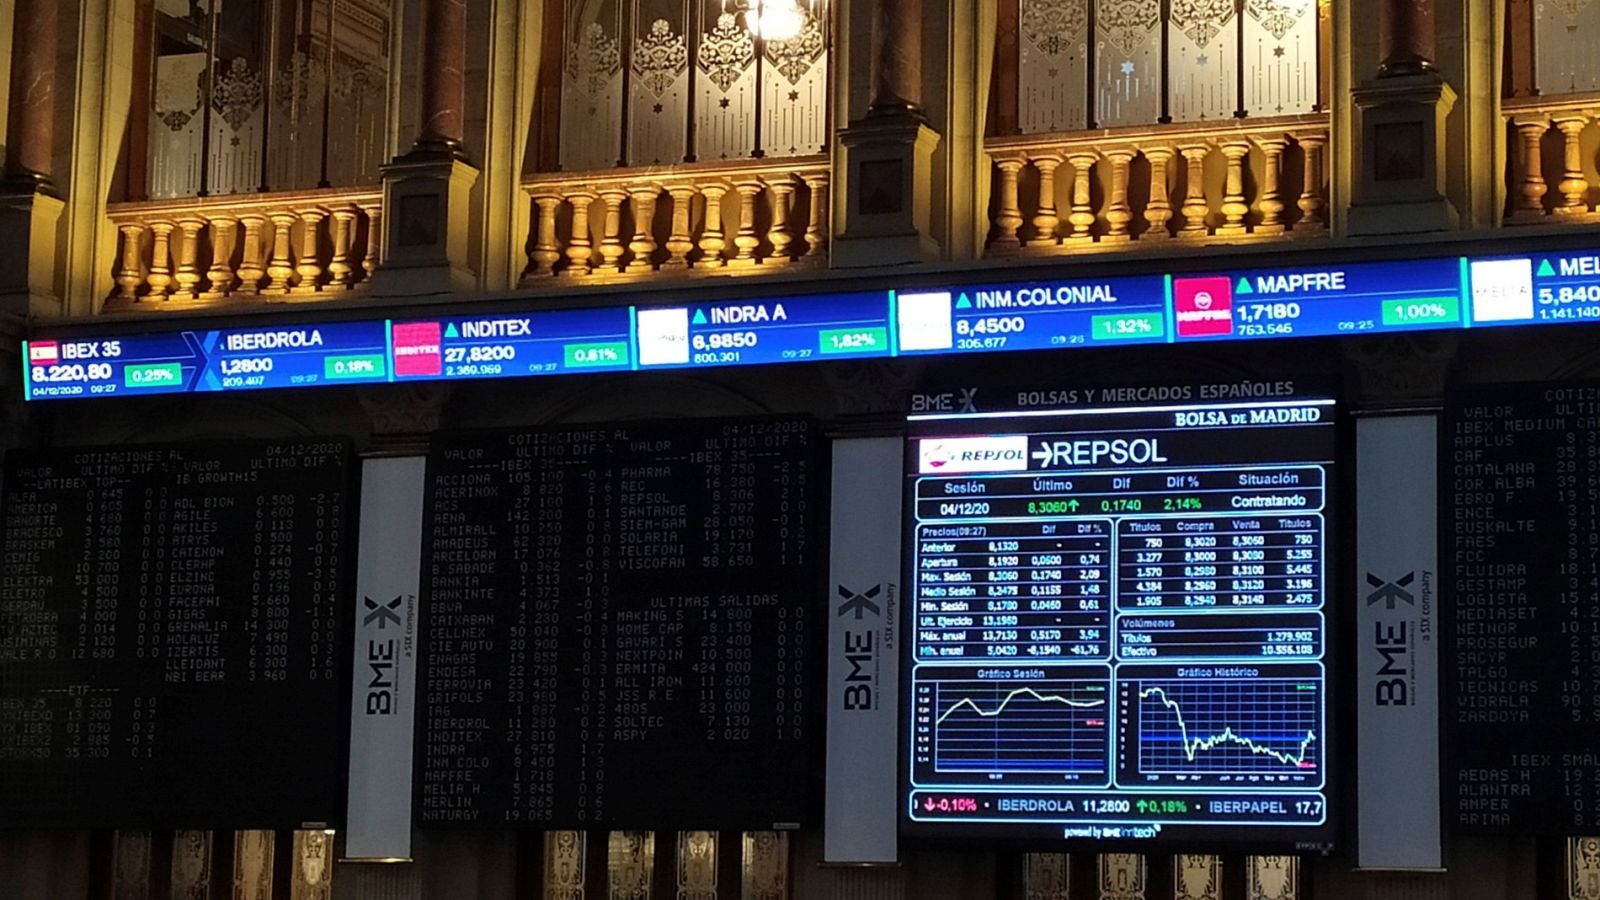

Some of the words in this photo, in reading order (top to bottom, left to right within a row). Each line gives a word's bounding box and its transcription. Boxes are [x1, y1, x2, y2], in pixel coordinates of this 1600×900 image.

[1257, 273, 1345, 293] MAPFRE
[976, 286, 1117, 309] INM.COLONIAL
[711, 306, 769, 324] INDRA
[773, 305, 787, 320] A
[1237, 303, 1300, 321] 1,7180
[1394, 305, 1446, 320] 1,00%
[462, 319, 531, 337] INDITEX
[957, 317, 1024, 337] 8,4500
[1104, 319, 1151, 334] 1,32%
[227, 331, 322, 350] IBERDROLA
[692, 333, 756, 350] 6,9850
[62, 343, 99, 359] IBEX
[102, 342, 121, 356] 35
[445, 346, 515, 363] 27,8200
[32, 364, 112, 382] 8.220,80
[132, 369, 173, 382] 0,25%
[33, 387, 82, 395] 04/12/2020
[911, 394, 953, 412] BME
[1018, 391, 1078, 407] BOLSAS
[1085, 391, 1093, 403] Y
[1102, 387, 1191, 402] MERCADOS
[1200, 382, 1294, 398] ESPAÑOLES
[1175, 412, 1227, 427] BOLSA
[1231, 414, 1248, 423] DE
[1251, 409, 1320, 423] MADRID
[1464, 406, 1514, 418] VALOR
[1454, 434, 1515, 448] APPLUS
[961, 450, 1024, 460] REPSOL
[1053, 439, 1167, 465] REPSOL
[1454, 463, 1536, 476] CATALANA
[945, 482, 985, 494] Sesión
[1033, 478, 1072, 491] Último
[1113, 478, 1130, 489] Dif
[1167, 477, 1184, 488] Dif
[1186, 477, 1199, 487] %
[1239, 474, 1299, 485] Situación
[940, 502, 990, 515] 04/12/20
[1028, 501, 1067, 513] 8,3060
[1101, 499, 1141, 513] 0,1740
[1163, 498, 1201, 511] 2,14%
[1231, 494, 1306, 507] Contratando
[1177, 522, 1214, 532] Compra
[1232, 521, 1260, 530] Venta
[1455, 520, 1536, 533] EUSKALTE
[1146, 539, 1162, 547] 750
[1295, 535, 1312, 544] 750
[1456, 563, 1527, 576] FLUIDRA
[1456, 578, 1527, 591] GESTAMP
[1421, 571, 1432, 616] company
[1456, 592, 1527, 606] LOGISTA
[886, 583, 896, 626] company
[406, 594, 415, 635] company
[1421, 619, 1430, 633] SIX
[885, 628, 893, 642] SIX
[1456, 636, 1539, 649] PROSEGUR
[844, 631, 872, 710] BME
[1376, 621, 1407, 706] BME
[366, 640, 393, 715] BME
[977, 670, 1011, 679] Gráfico
[1013, 669, 1045, 678] Sesión
[1177, 668, 1212, 677] Gráfico
[1215, 668, 1259, 677] Histórico
[1458, 710, 1529, 723] ZARDOYA
[1459, 784, 1531, 796] ALANTRA
[998, 800, 1074, 811] IBERDROLA
[1083, 800, 1130, 812] 11,2800
[1149, 801, 1187, 814] 0,18%
[1209, 801, 1287, 813] IBERPAPEL
